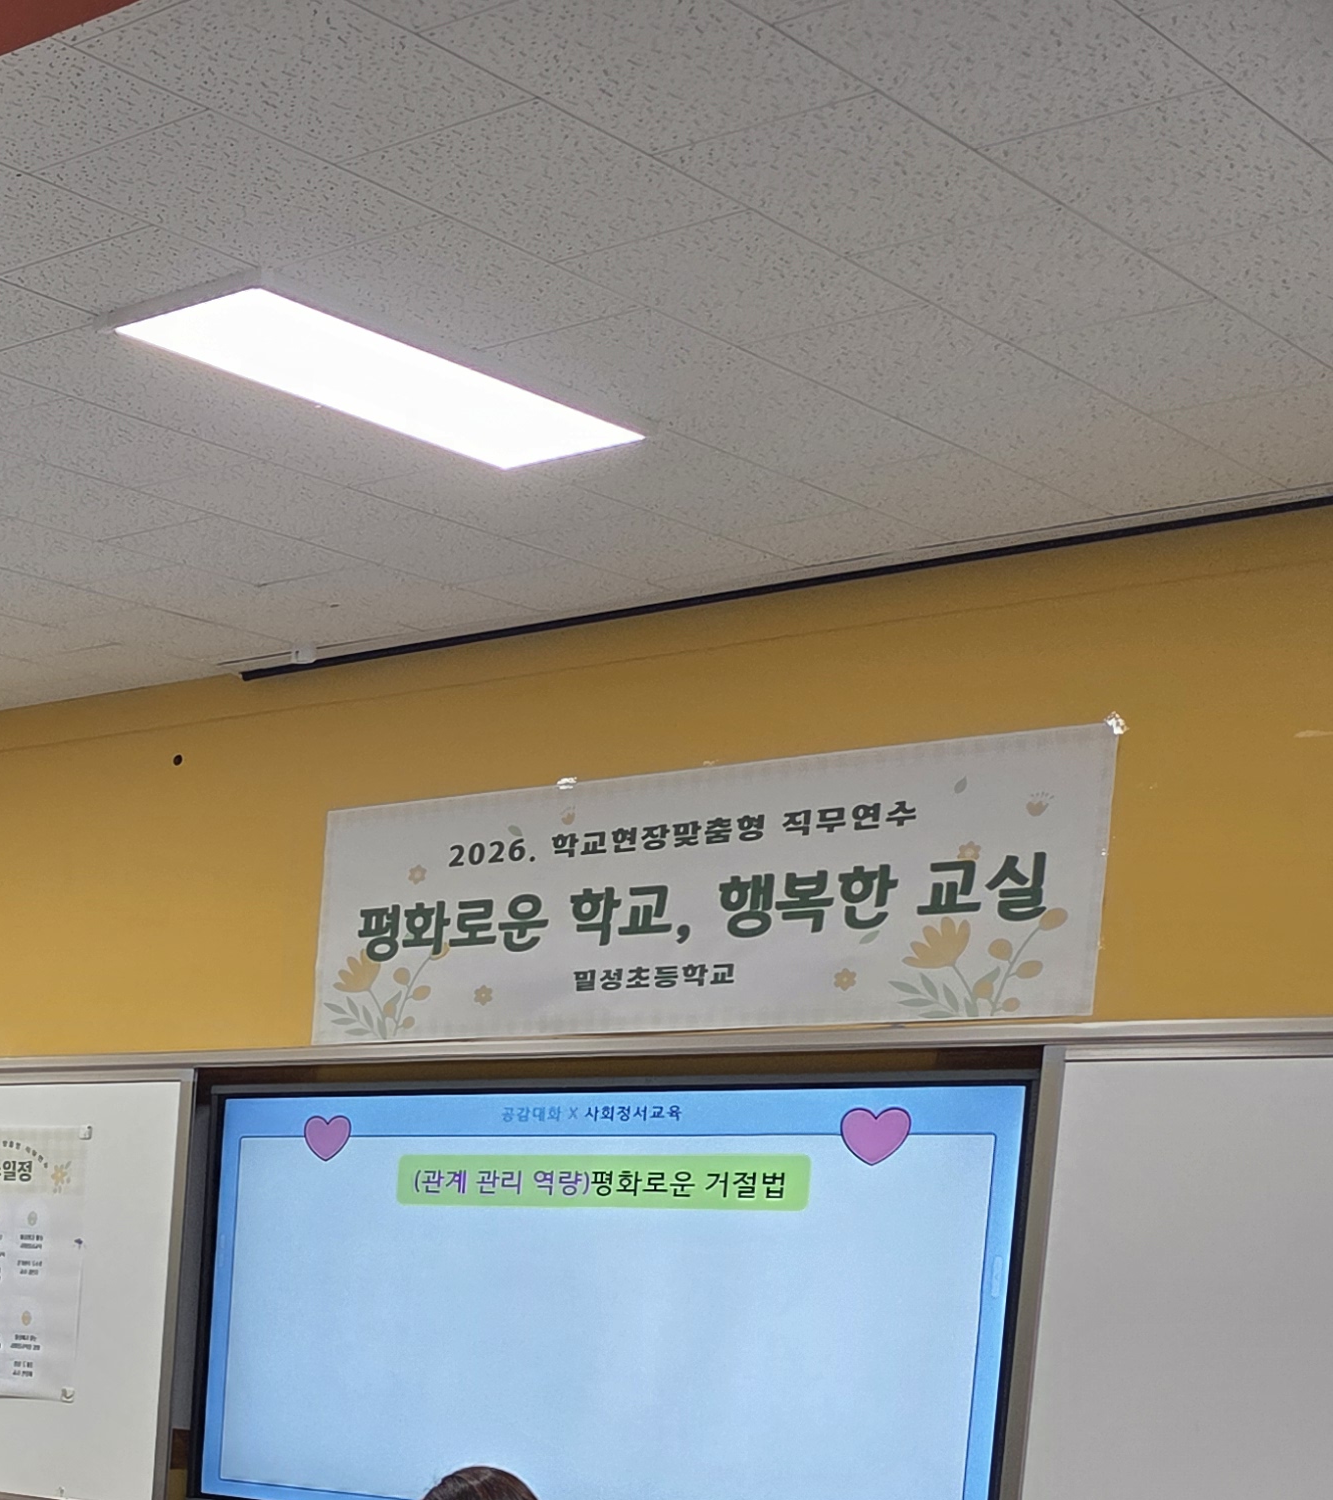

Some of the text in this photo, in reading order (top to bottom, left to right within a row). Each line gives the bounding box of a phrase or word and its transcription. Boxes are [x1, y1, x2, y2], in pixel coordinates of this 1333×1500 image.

[449, 801, 917, 868] 2026. 학교현장맞춤형 직무연수
[357, 851, 1048, 963] 평화로운 학교, 행복한 교실
[573, 963, 735, 992] 밀성초등학교
[501, 1106, 562, 1123] 공감대화
[584, 1104, 682, 1122] 사회정서교육
[414, 1169, 467, 1195] (관계
[476, 1170, 523, 1195] 관리
[705, 1171, 786, 1199] 거절법
